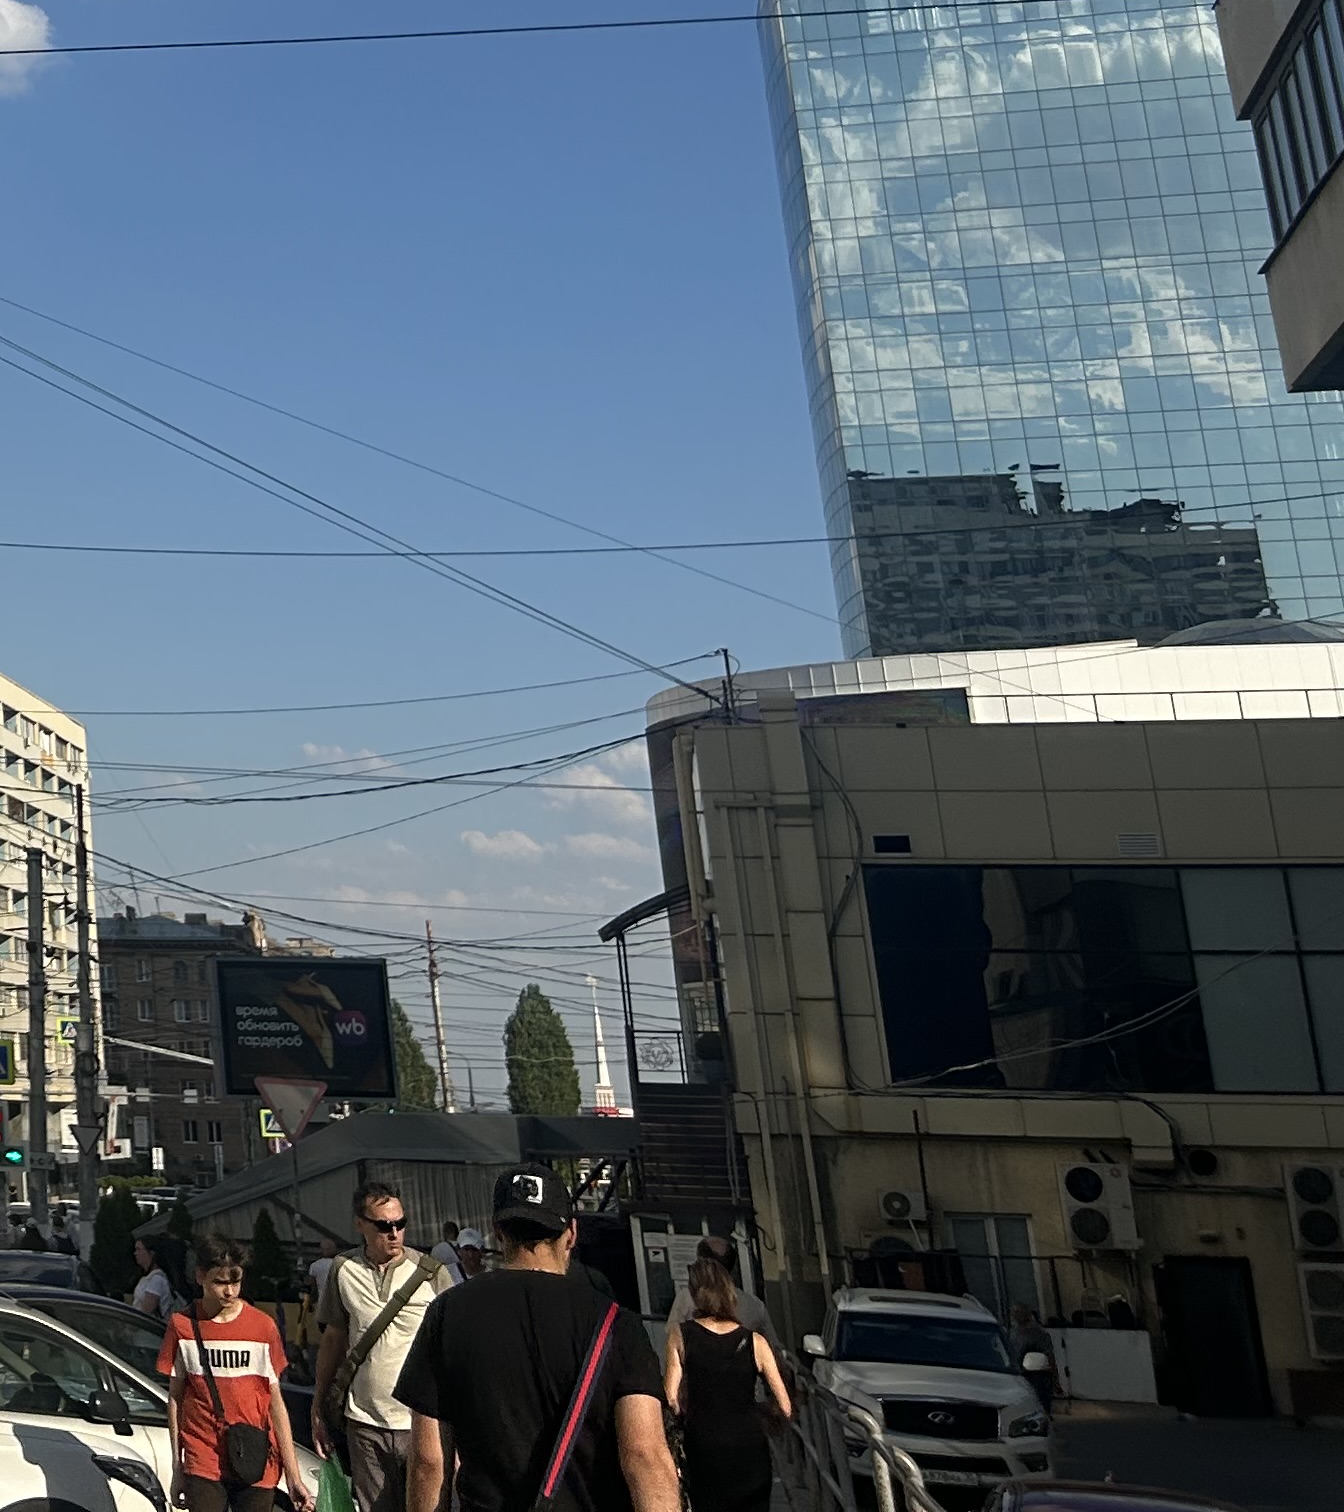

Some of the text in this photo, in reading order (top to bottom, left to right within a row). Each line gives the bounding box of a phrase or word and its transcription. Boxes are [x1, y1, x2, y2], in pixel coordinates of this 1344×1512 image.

[236, 1006, 278, 1018] время
[237, 1019, 300, 1031] обновить
[336, 1018, 365, 1035] wb
[238, 1035, 303, 1048] гардероб
